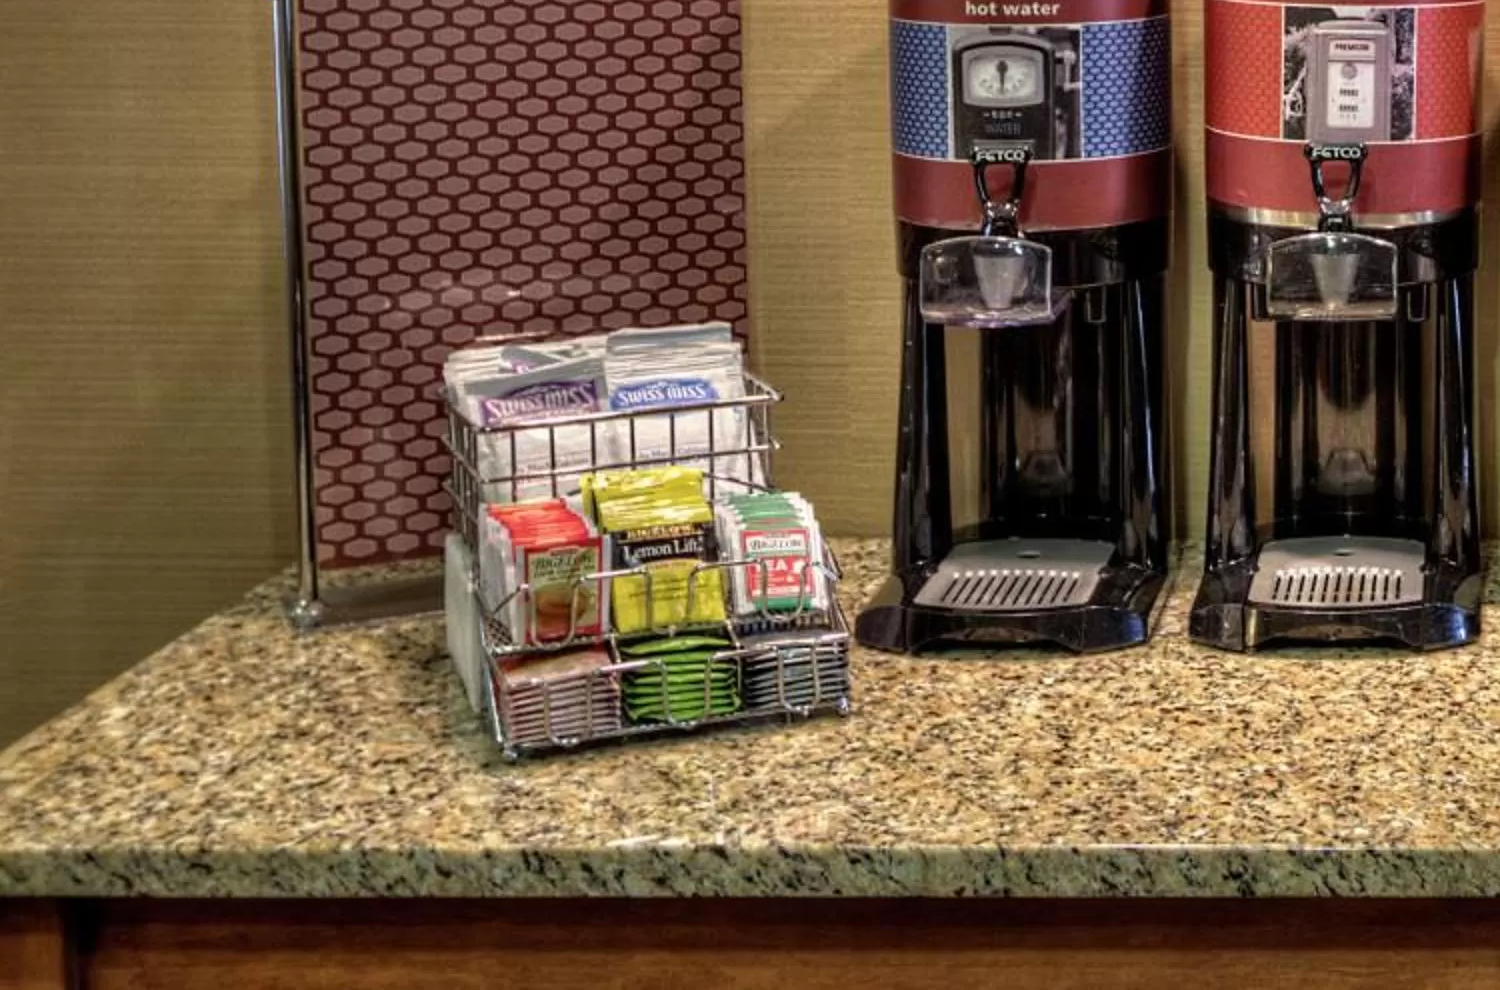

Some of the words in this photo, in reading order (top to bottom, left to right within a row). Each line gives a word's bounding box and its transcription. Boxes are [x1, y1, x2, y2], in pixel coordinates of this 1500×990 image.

[965, 0, 997, 16] hot
[1003, 1, 1061, 16] water
[623, 540, 673, 564] Lemon
[673, 535, 699, 554] Lift
